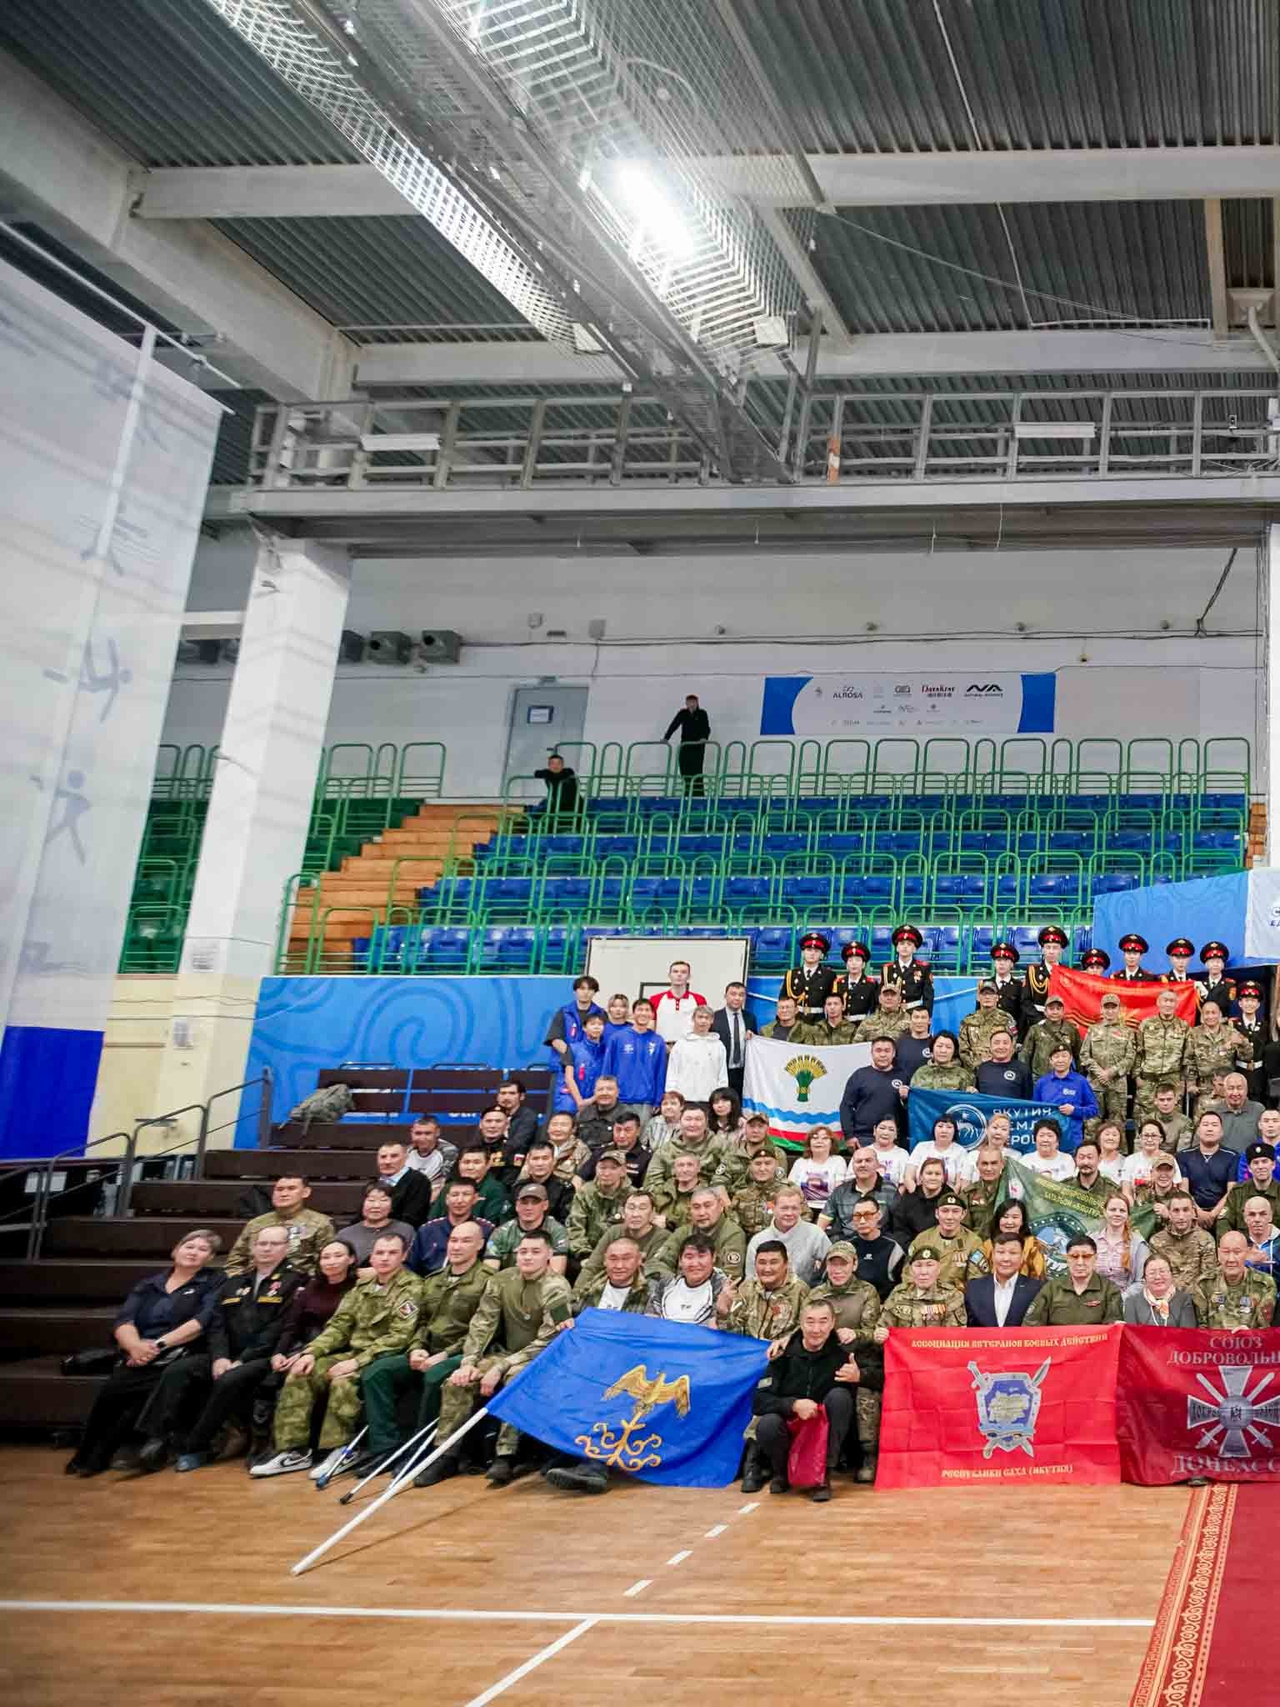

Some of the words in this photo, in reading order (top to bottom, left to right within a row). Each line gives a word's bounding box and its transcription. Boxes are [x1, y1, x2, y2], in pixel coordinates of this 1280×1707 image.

[1024, 1339, 1059, 1348] БОЕВЫХ
[1209, 1336, 1263, 1349] СОЮЗ
[1003, 1466, 1028, 1477] САХА
